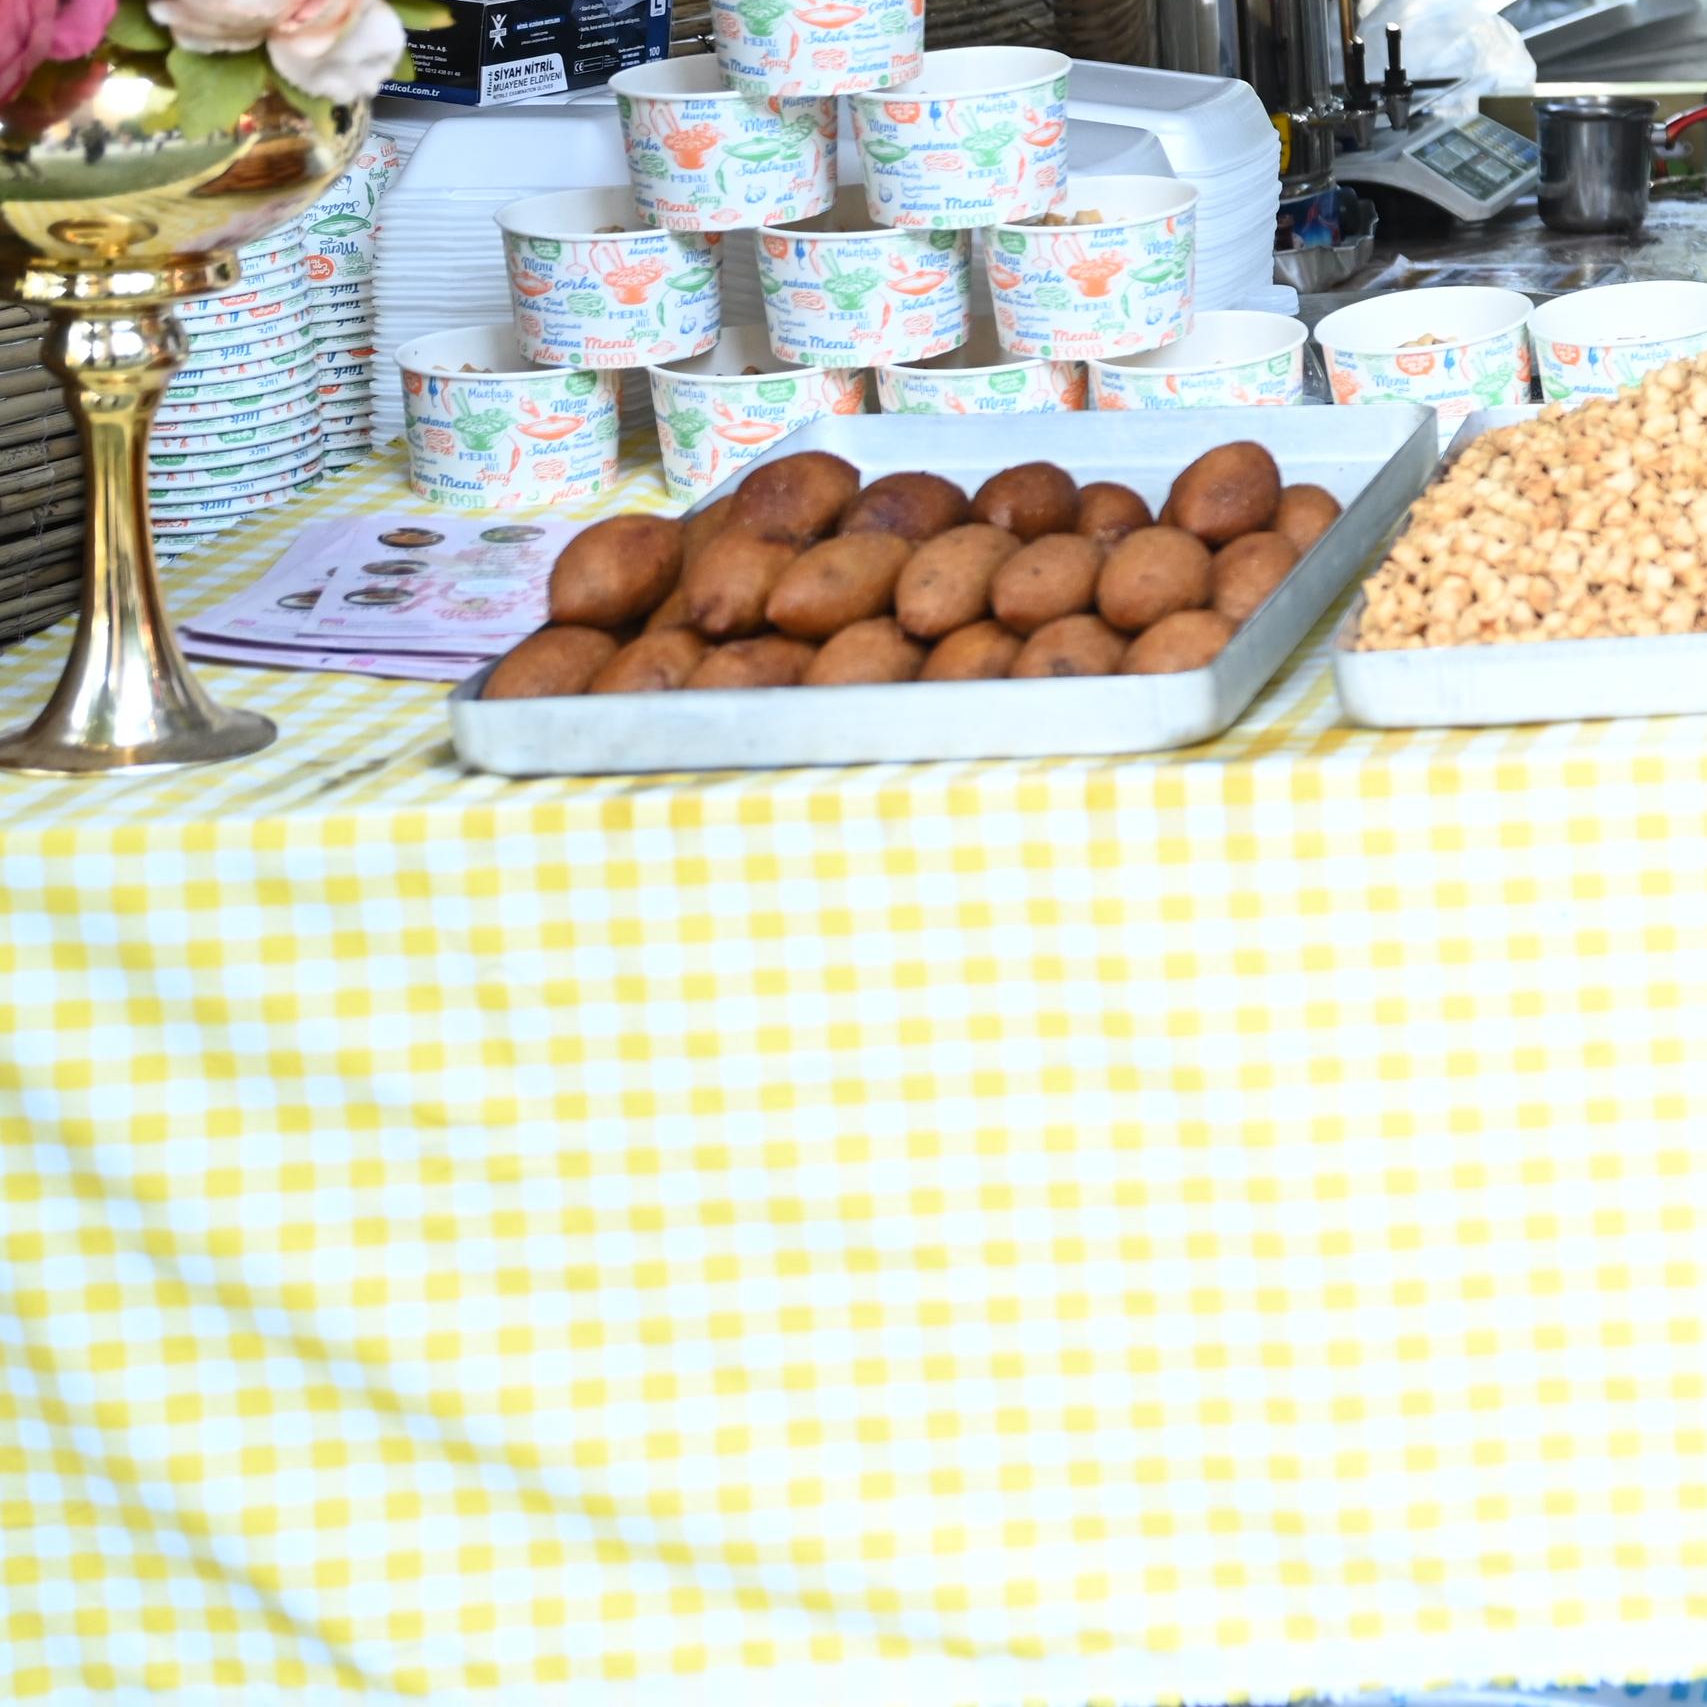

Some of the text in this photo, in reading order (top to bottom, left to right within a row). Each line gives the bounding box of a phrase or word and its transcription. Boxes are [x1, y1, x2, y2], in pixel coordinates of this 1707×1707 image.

[493, 69, 562, 92] MUAYENE ELDİVENİ
[494, 59, 554, 81] SİYAH NİTRİL
